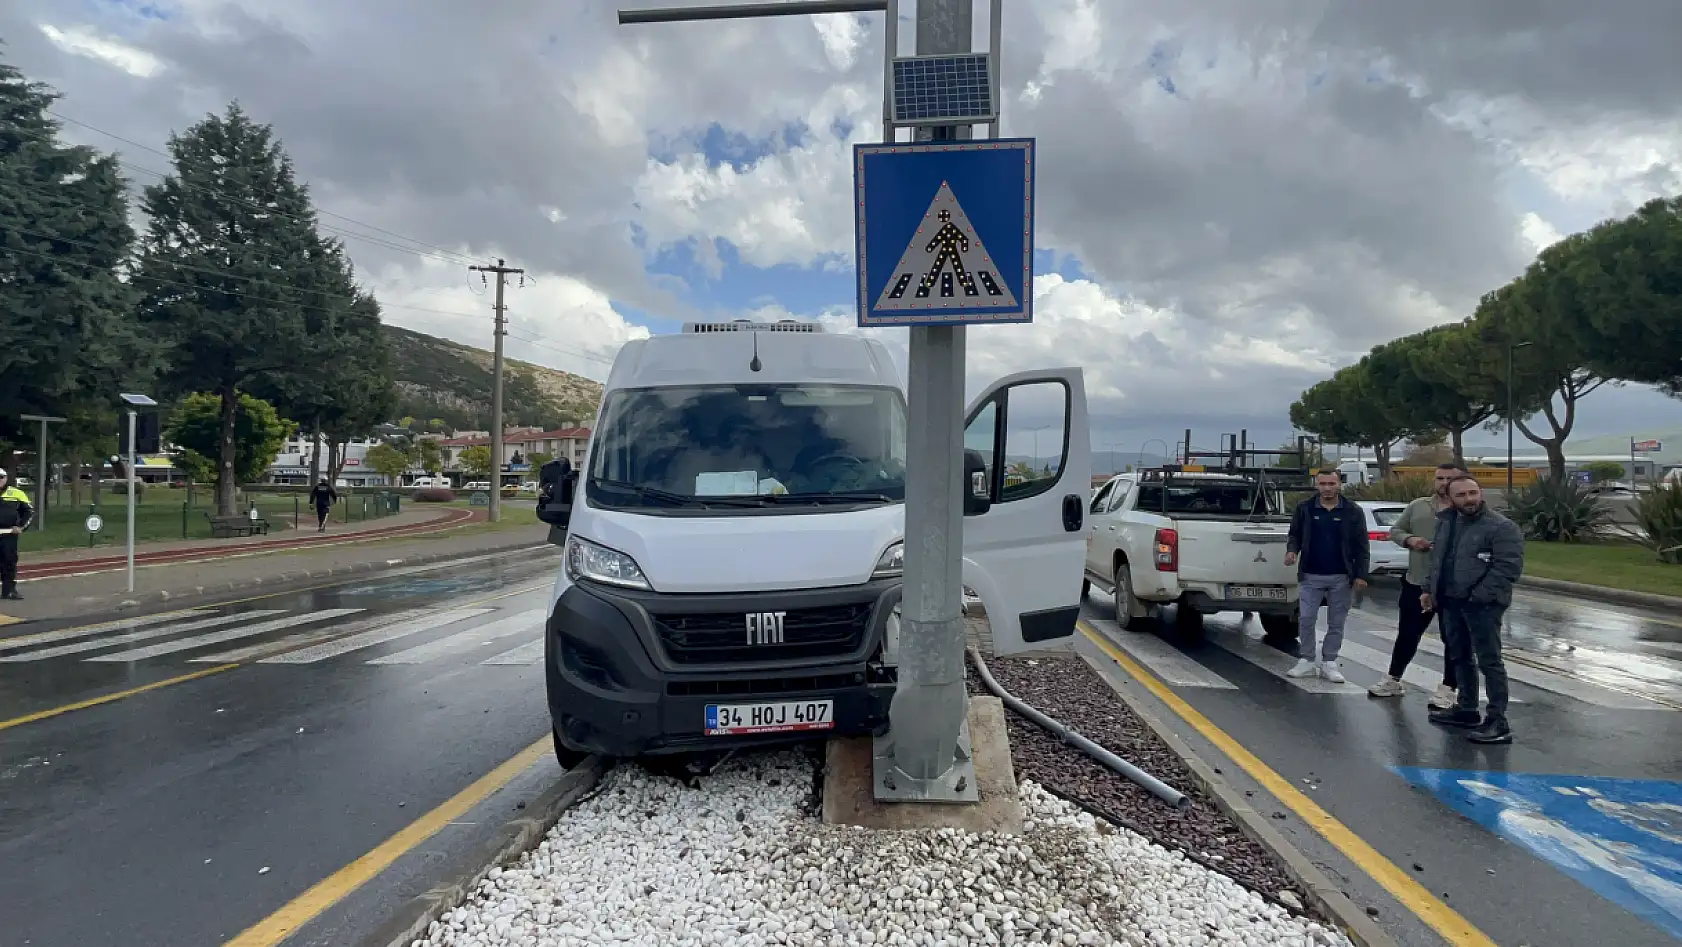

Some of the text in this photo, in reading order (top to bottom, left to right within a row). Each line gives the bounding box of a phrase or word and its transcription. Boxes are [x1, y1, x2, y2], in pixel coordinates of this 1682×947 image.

[745, 611, 787, 646] FIAT
[719, 703, 828, 726] 34 HOJ 407
